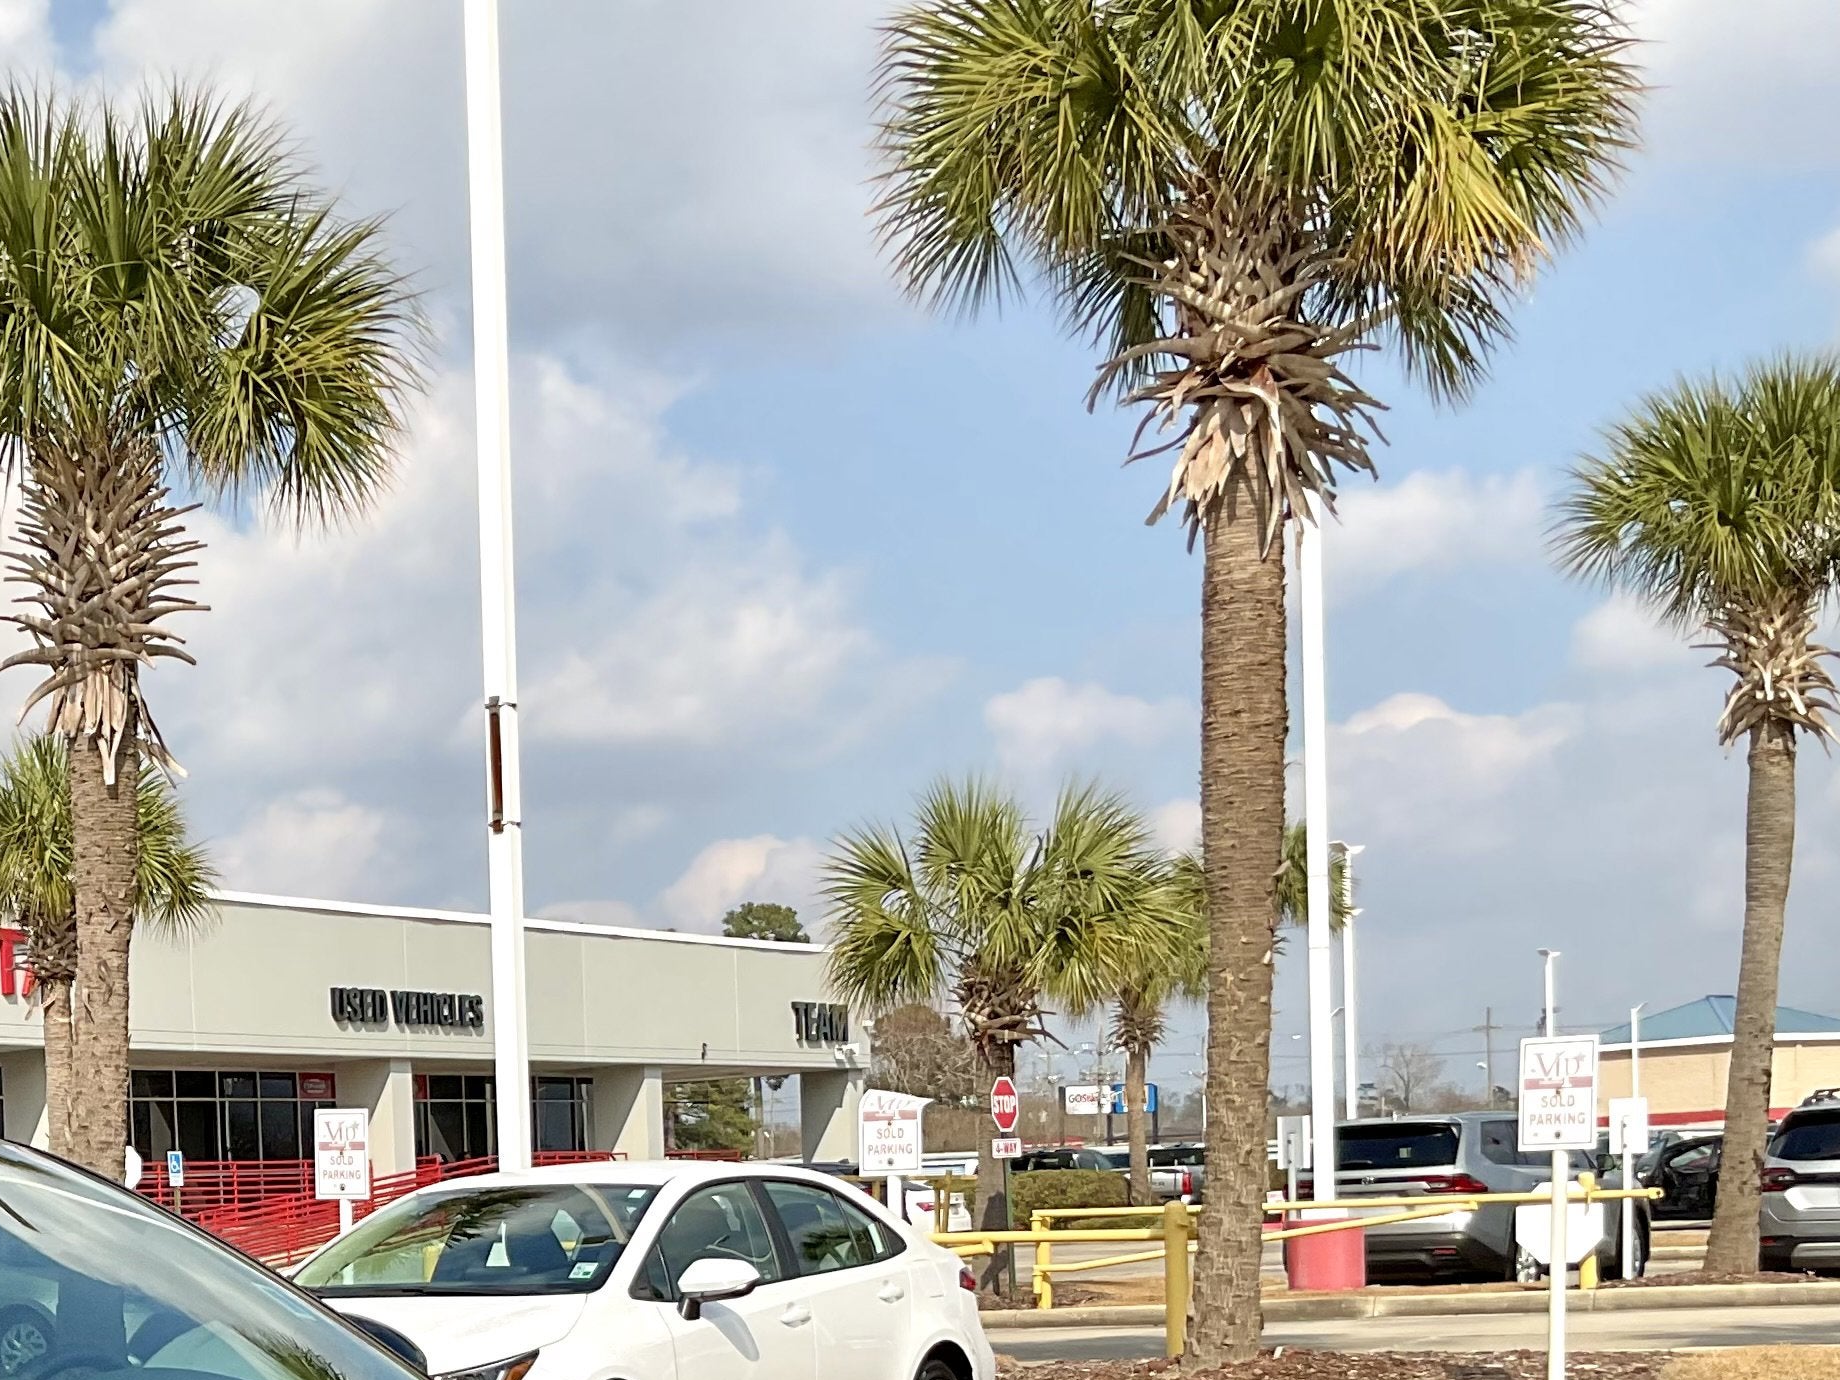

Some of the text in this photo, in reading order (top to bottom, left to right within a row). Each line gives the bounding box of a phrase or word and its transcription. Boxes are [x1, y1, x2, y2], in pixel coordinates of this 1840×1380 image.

[330, 987, 484, 1028] USED VEHICLES
[791, 1001, 849, 1041] TEAM
[993, 1094, 1016, 1114] STOP
[1540, 1095, 1575, 1107] SOLD
[1529, 1112, 1586, 1125] PARKING
[876, 1127, 904, 1140] SOLD
[867, 1143, 913, 1156] PARKING
[995, 1142, 1017, 1154] 4-WAY
[330, 1155, 354, 1166] SOLD
[322, 1169, 361, 1180] PARKING
